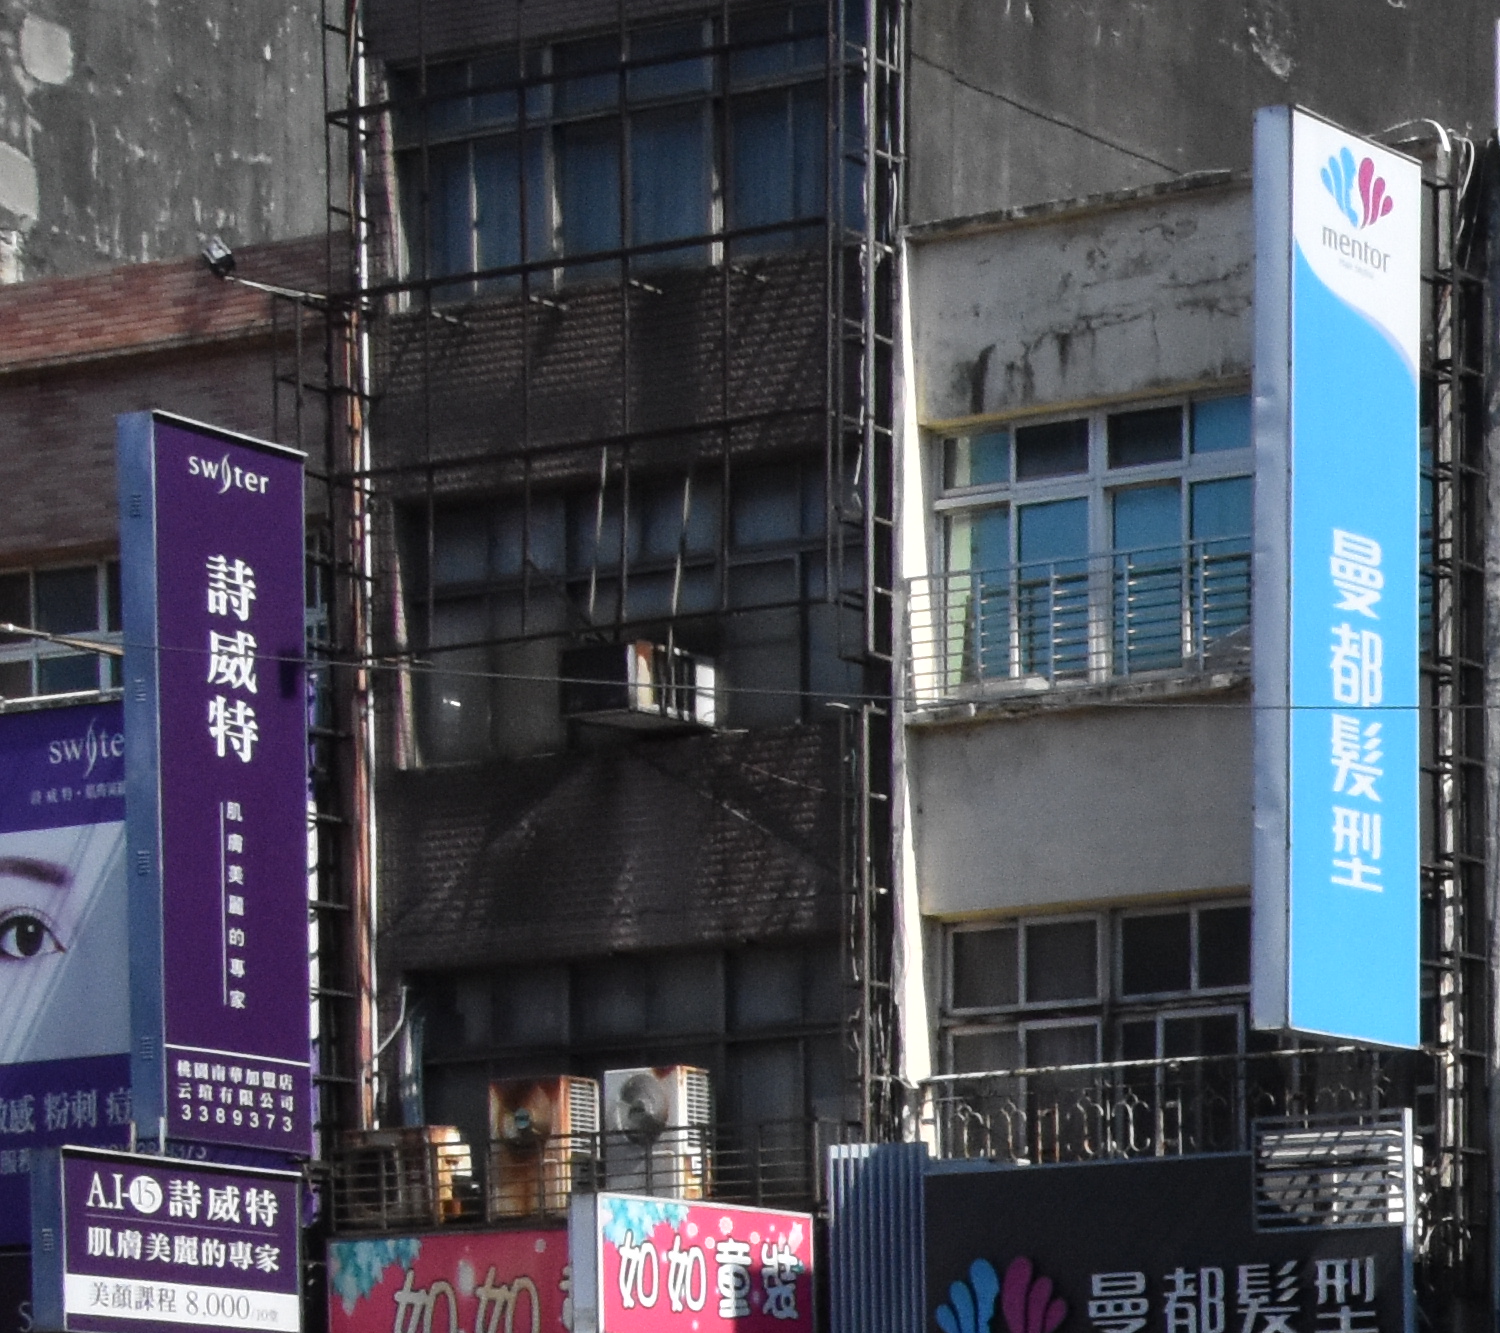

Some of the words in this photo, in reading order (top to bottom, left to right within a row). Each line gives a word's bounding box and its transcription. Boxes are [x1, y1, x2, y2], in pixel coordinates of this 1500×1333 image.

[1322, 226, 1391, 273] mentor
[206, 555, 259, 763] 詩威特
[1330, 527, 1384, 893] 曼都髮型
[226, 802, 246, 1010] 肌膚美麗的專家
[177, 1060, 293, 1091] 桃園南華加盟店
[181, 1105, 293, 1133] 3389373
[168, 1179, 278, 1227] 詩威特
[87, 1226, 281, 1274] 肌膚美麗的專家
[618, 1232, 798, 1320] 如如童裝
